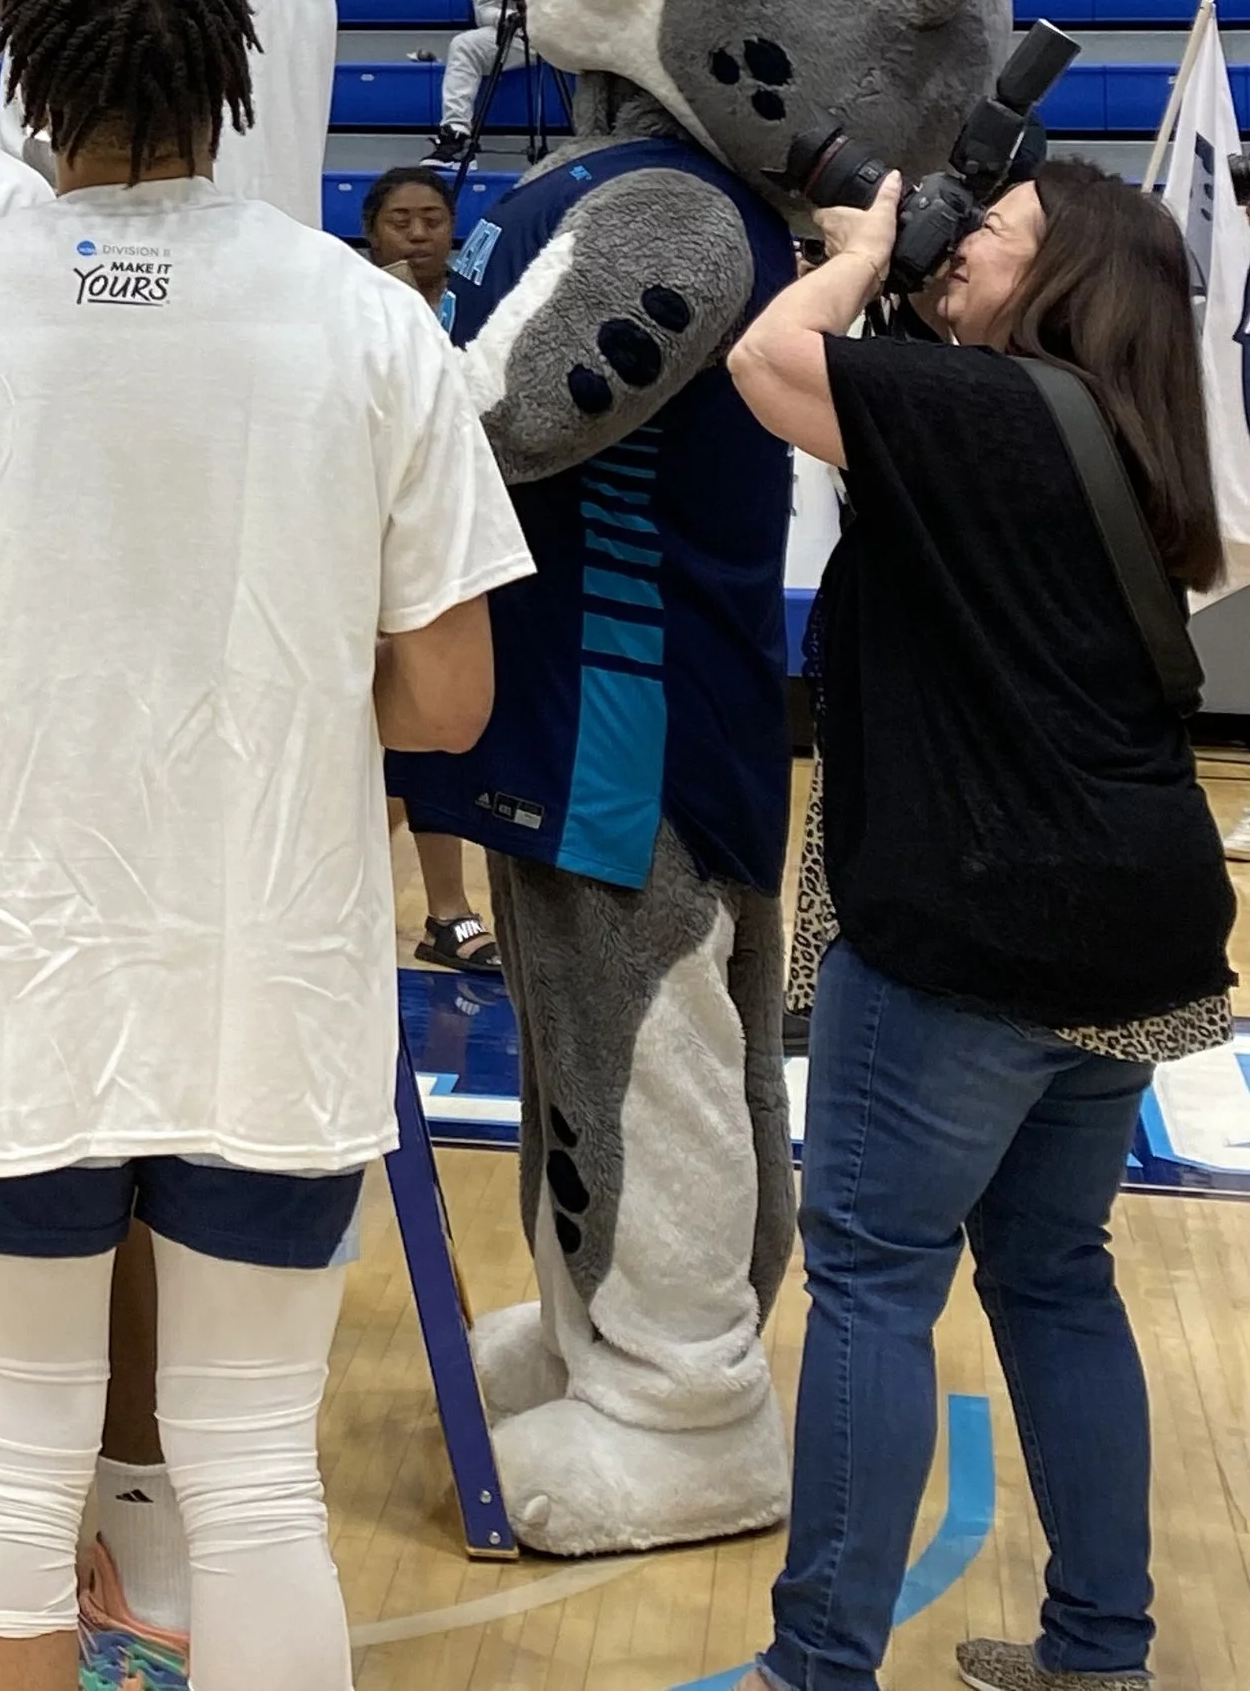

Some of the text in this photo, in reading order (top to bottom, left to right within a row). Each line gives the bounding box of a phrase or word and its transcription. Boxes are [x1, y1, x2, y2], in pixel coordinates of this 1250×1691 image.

[102, 244, 159, 257] DIVISION
[110, 261, 173, 275] MAKE IT
[73, 264, 171, 306] YOURS
[453, 920, 487, 943] NIK
